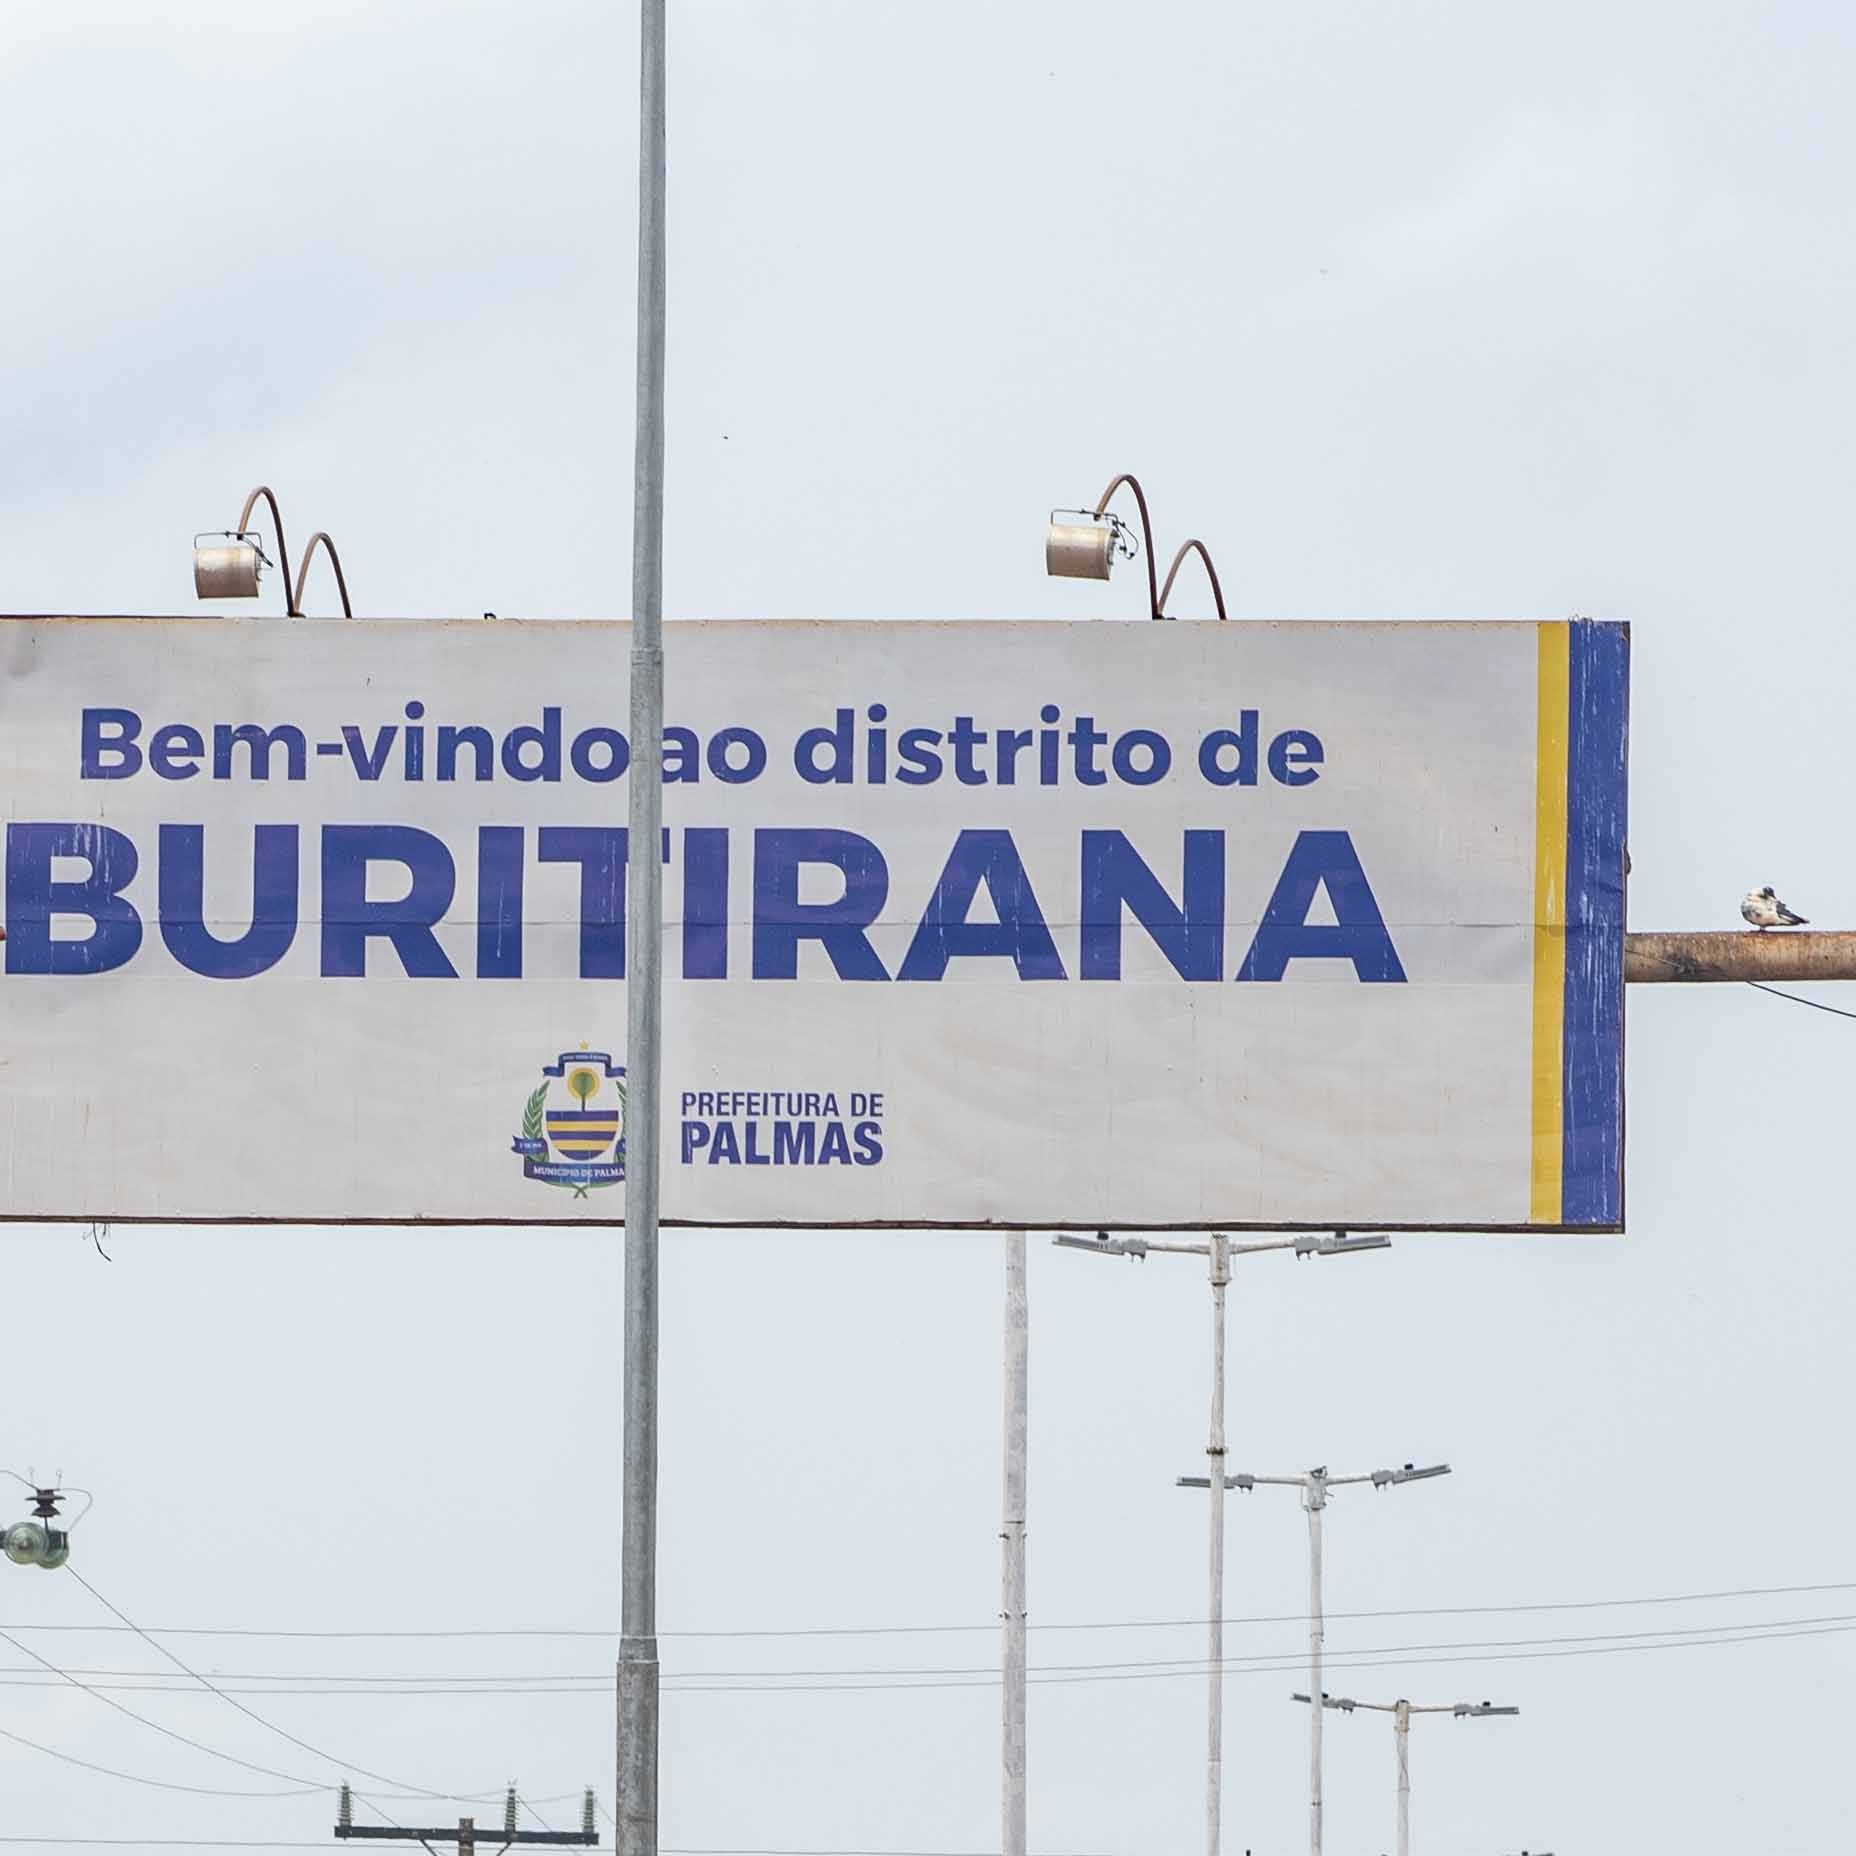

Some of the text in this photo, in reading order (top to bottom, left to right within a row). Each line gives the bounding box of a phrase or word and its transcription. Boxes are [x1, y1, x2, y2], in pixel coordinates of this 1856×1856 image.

[79, 701, 1324, 787] Bem-vindo ao distrito de
[4, 820, 1408, 984] BURITIRANA
[681, 1092, 884, 1118] PREFEITURA DE
[681, 1121, 884, 1167] PALMAS
[594, 1167, 625, 1178] PALMA
